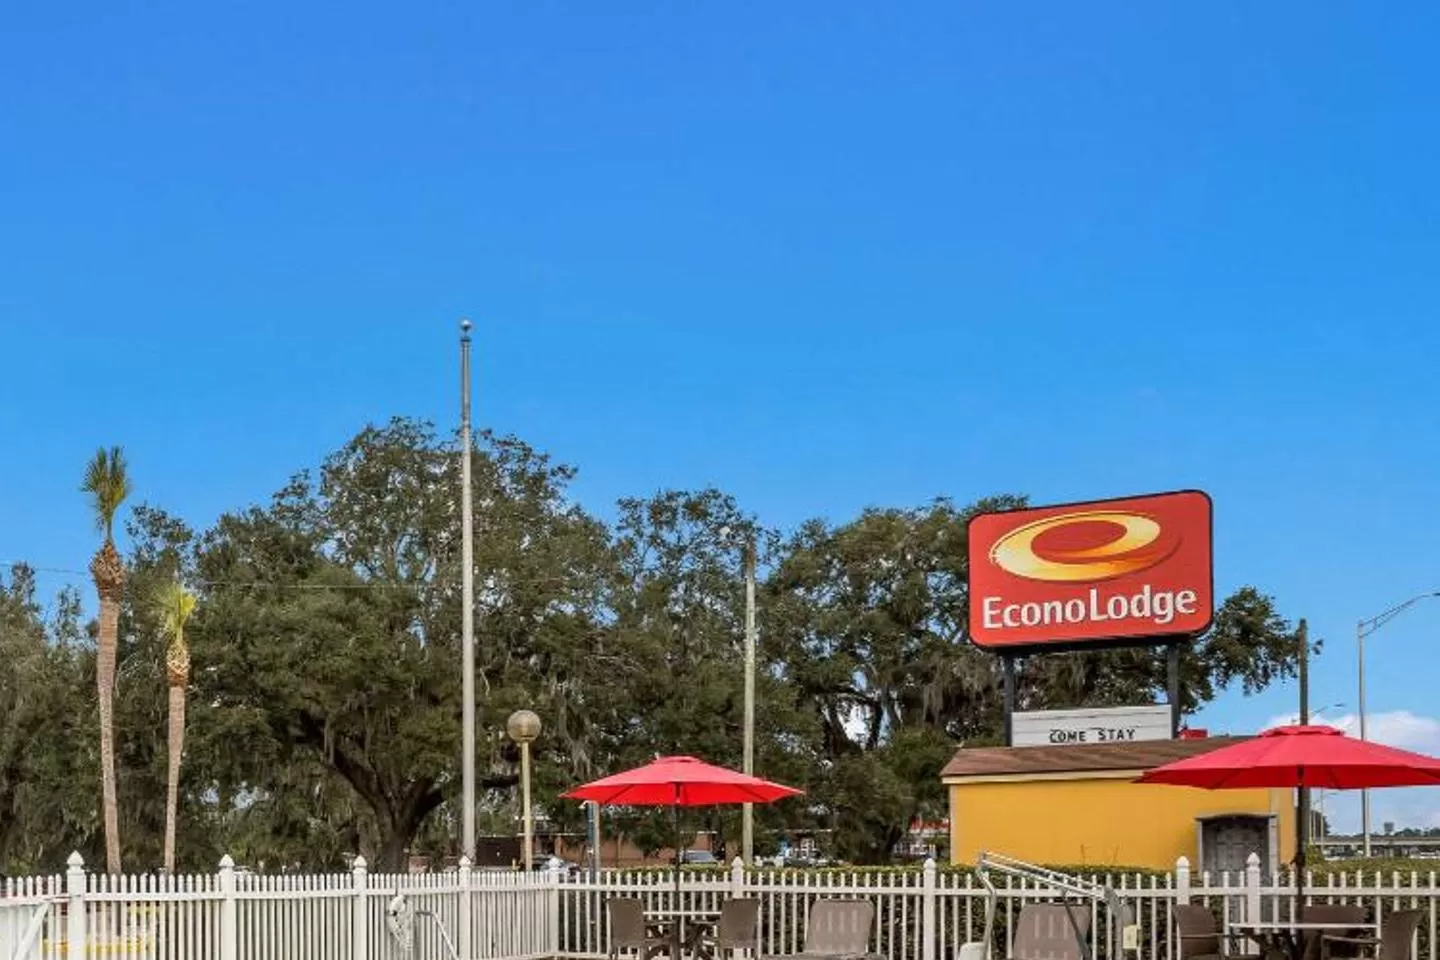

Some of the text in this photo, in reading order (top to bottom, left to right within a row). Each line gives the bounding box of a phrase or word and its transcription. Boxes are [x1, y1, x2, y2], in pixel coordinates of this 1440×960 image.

[982, 585, 1197, 629] EconoLodge
[1050, 728, 1135, 743] COME STAY
